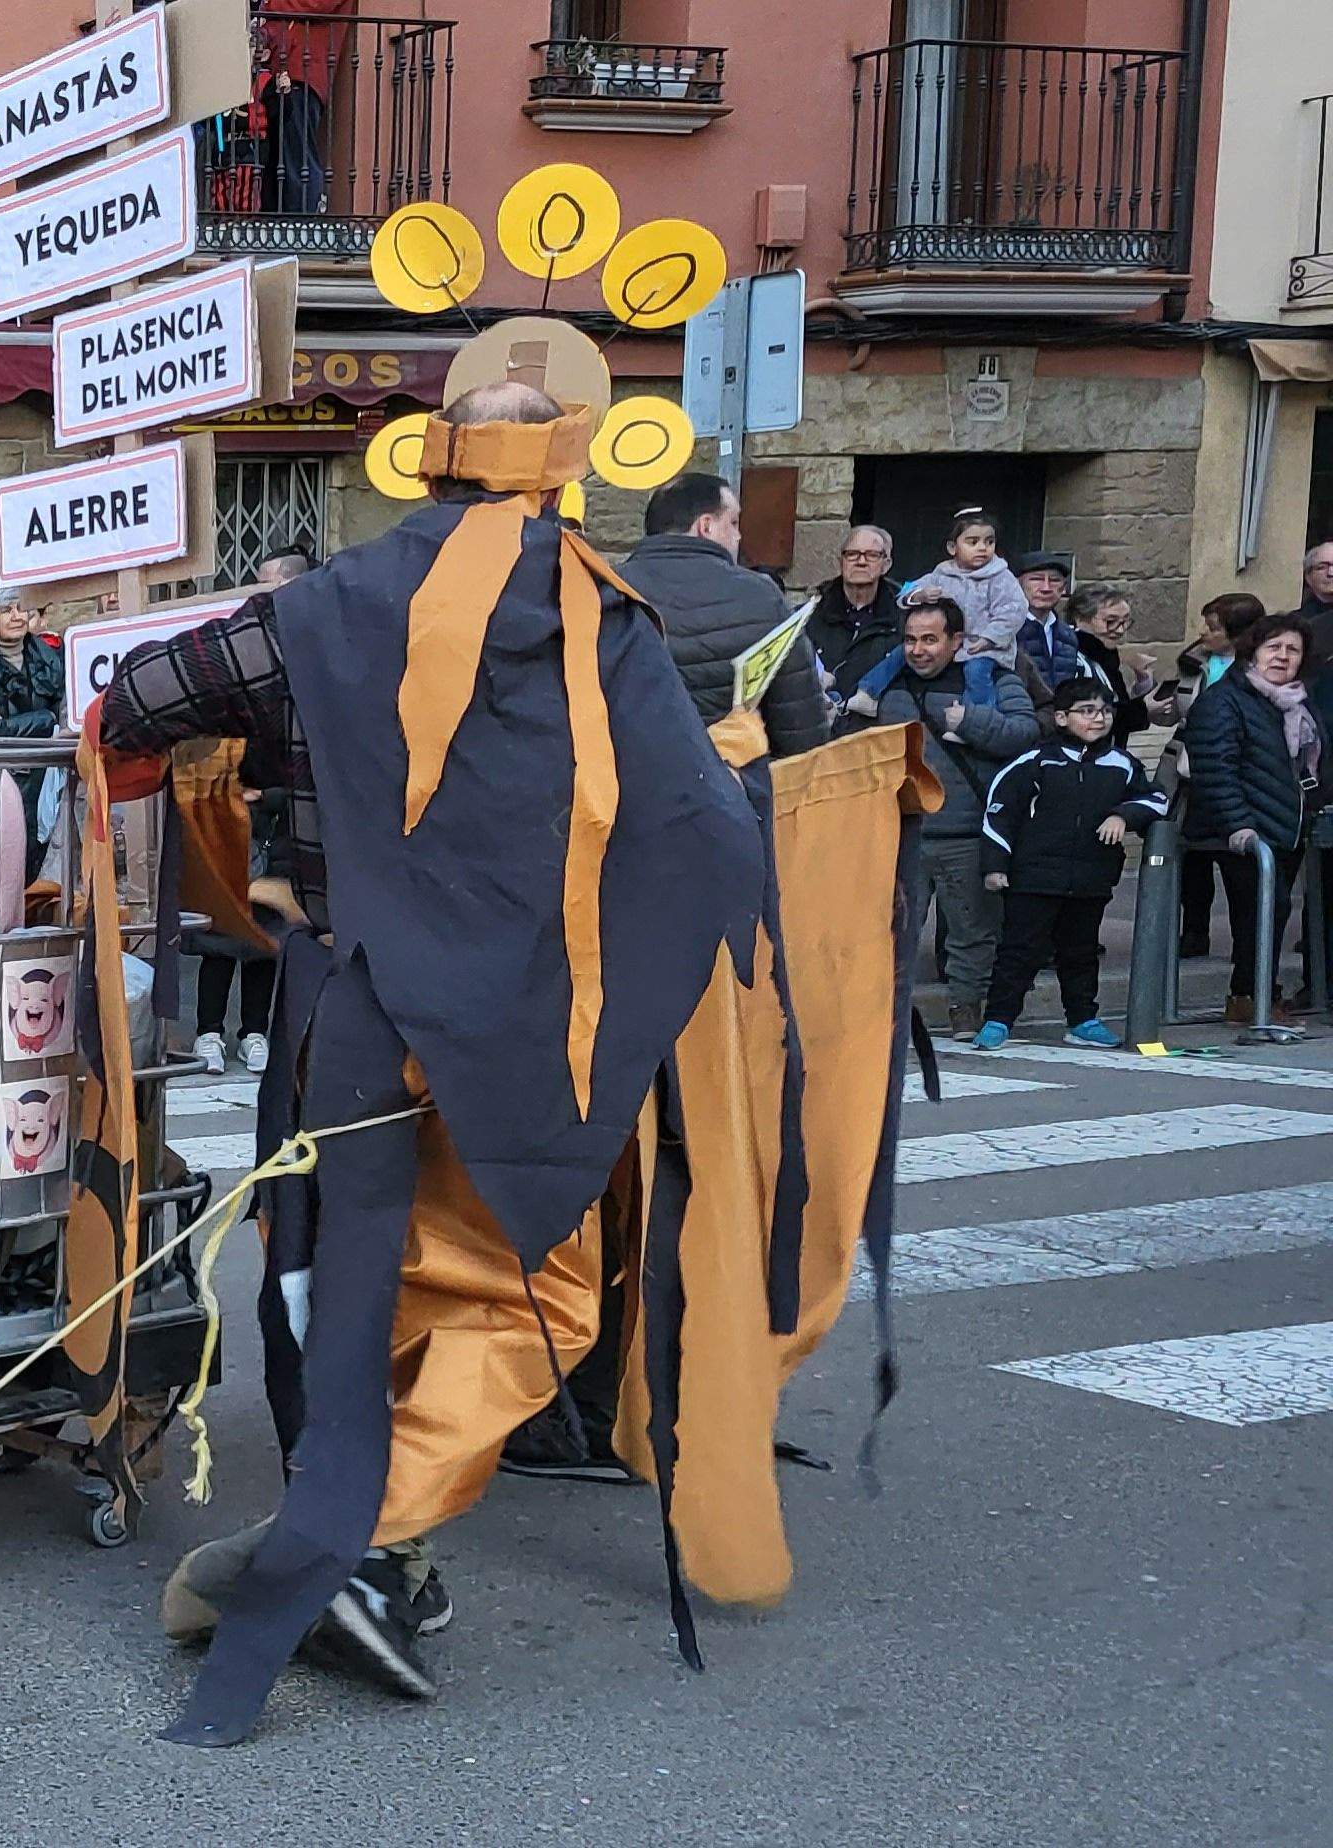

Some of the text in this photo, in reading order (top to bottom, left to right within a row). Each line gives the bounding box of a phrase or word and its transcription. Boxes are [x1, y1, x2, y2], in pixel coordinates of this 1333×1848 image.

[13, 183, 162, 268] YÉQUEDA
[80, 298, 224, 369] PLASENCIA
[81, 345, 228, 415] DEL MONTE
[23, 482, 150, 549] ALERRE
